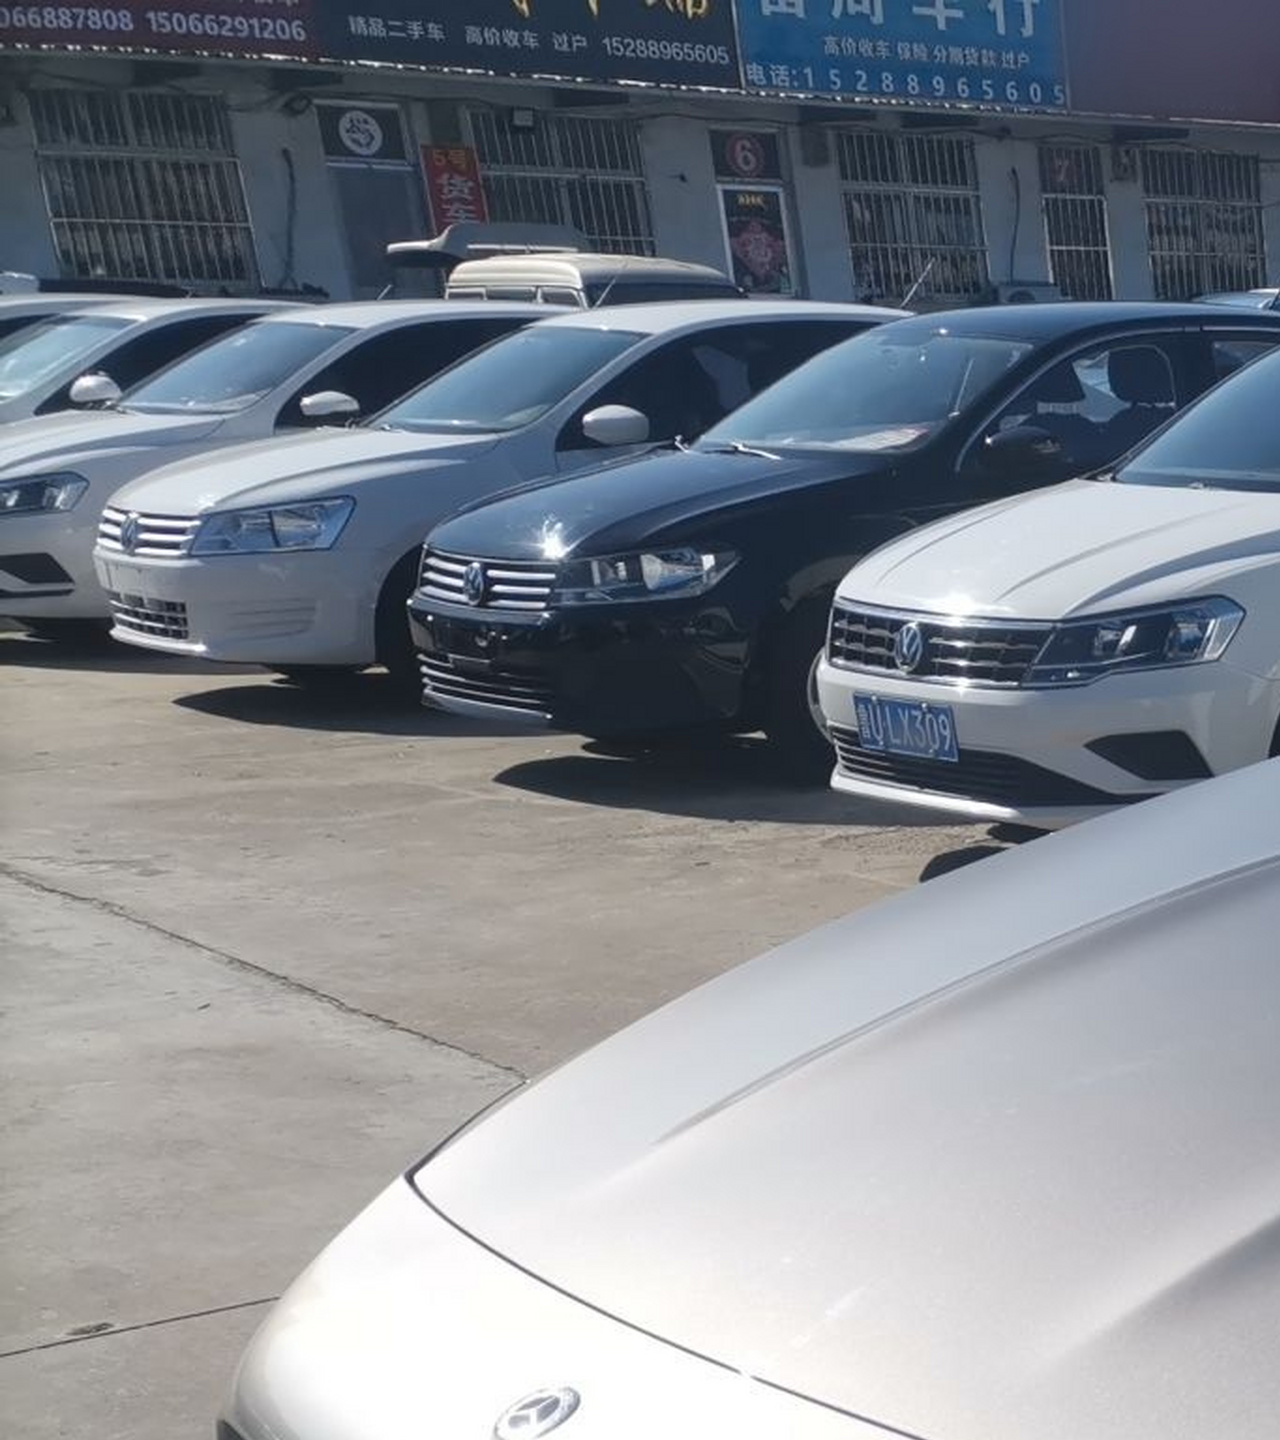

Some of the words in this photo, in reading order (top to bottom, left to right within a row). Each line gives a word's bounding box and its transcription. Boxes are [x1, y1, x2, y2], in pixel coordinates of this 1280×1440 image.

[146, 12, 306, 41] 15066291206
[349, 15, 446, 41] 精品二手车
[464, 26, 539, 49] 高价收车
[552, 31, 588, 52] 过户
[603, 36, 729, 65] 15288965605
[823, 36, 891, 58] 高价收车
[1001, 51, 1030, 69] 过户
[735, 138, 756, 172] 6
